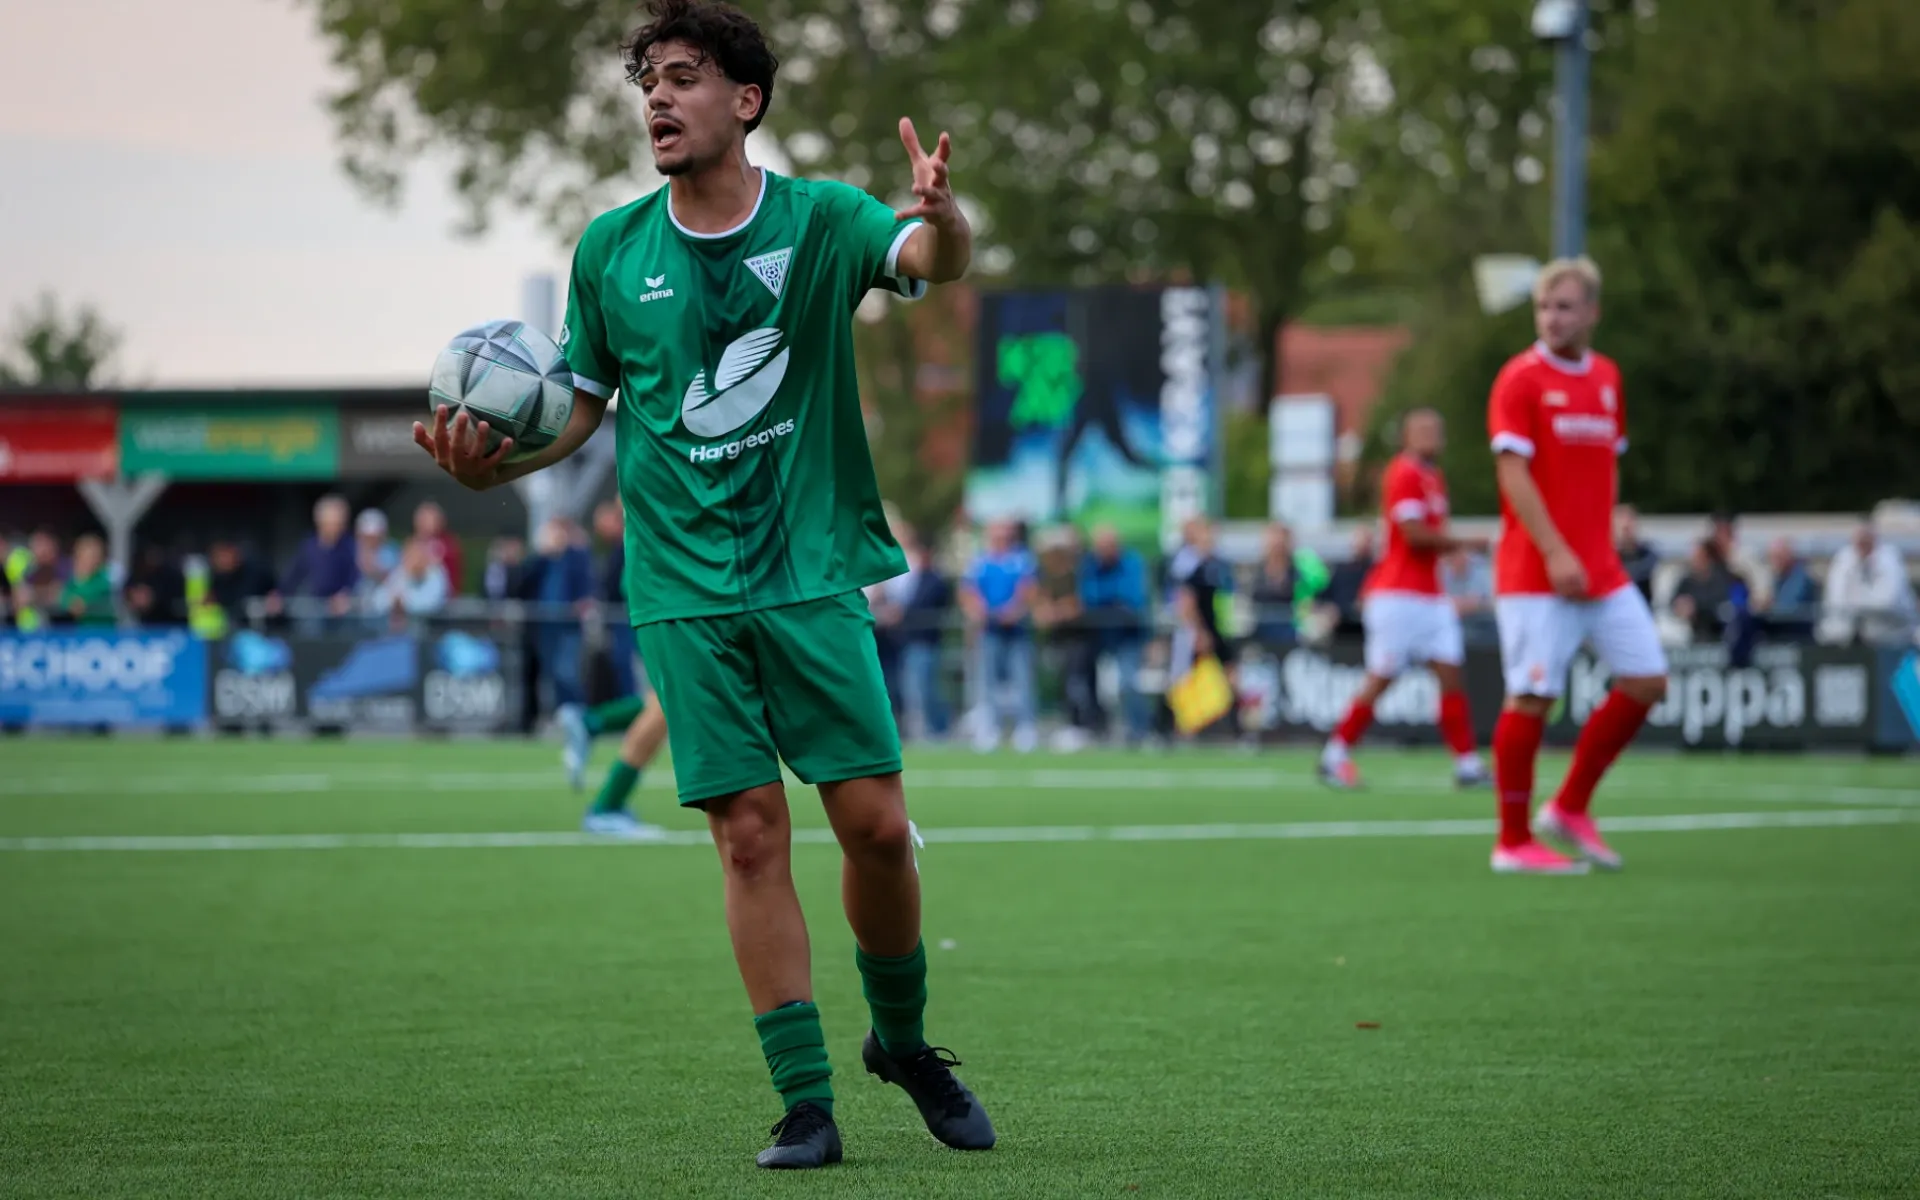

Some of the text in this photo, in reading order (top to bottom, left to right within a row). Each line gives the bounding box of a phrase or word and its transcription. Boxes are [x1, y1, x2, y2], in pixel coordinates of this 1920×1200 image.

[763, 253, 787, 263] KRAY
[639, 287, 674, 303] erima
[689, 418, 795, 463] Hargreaves
